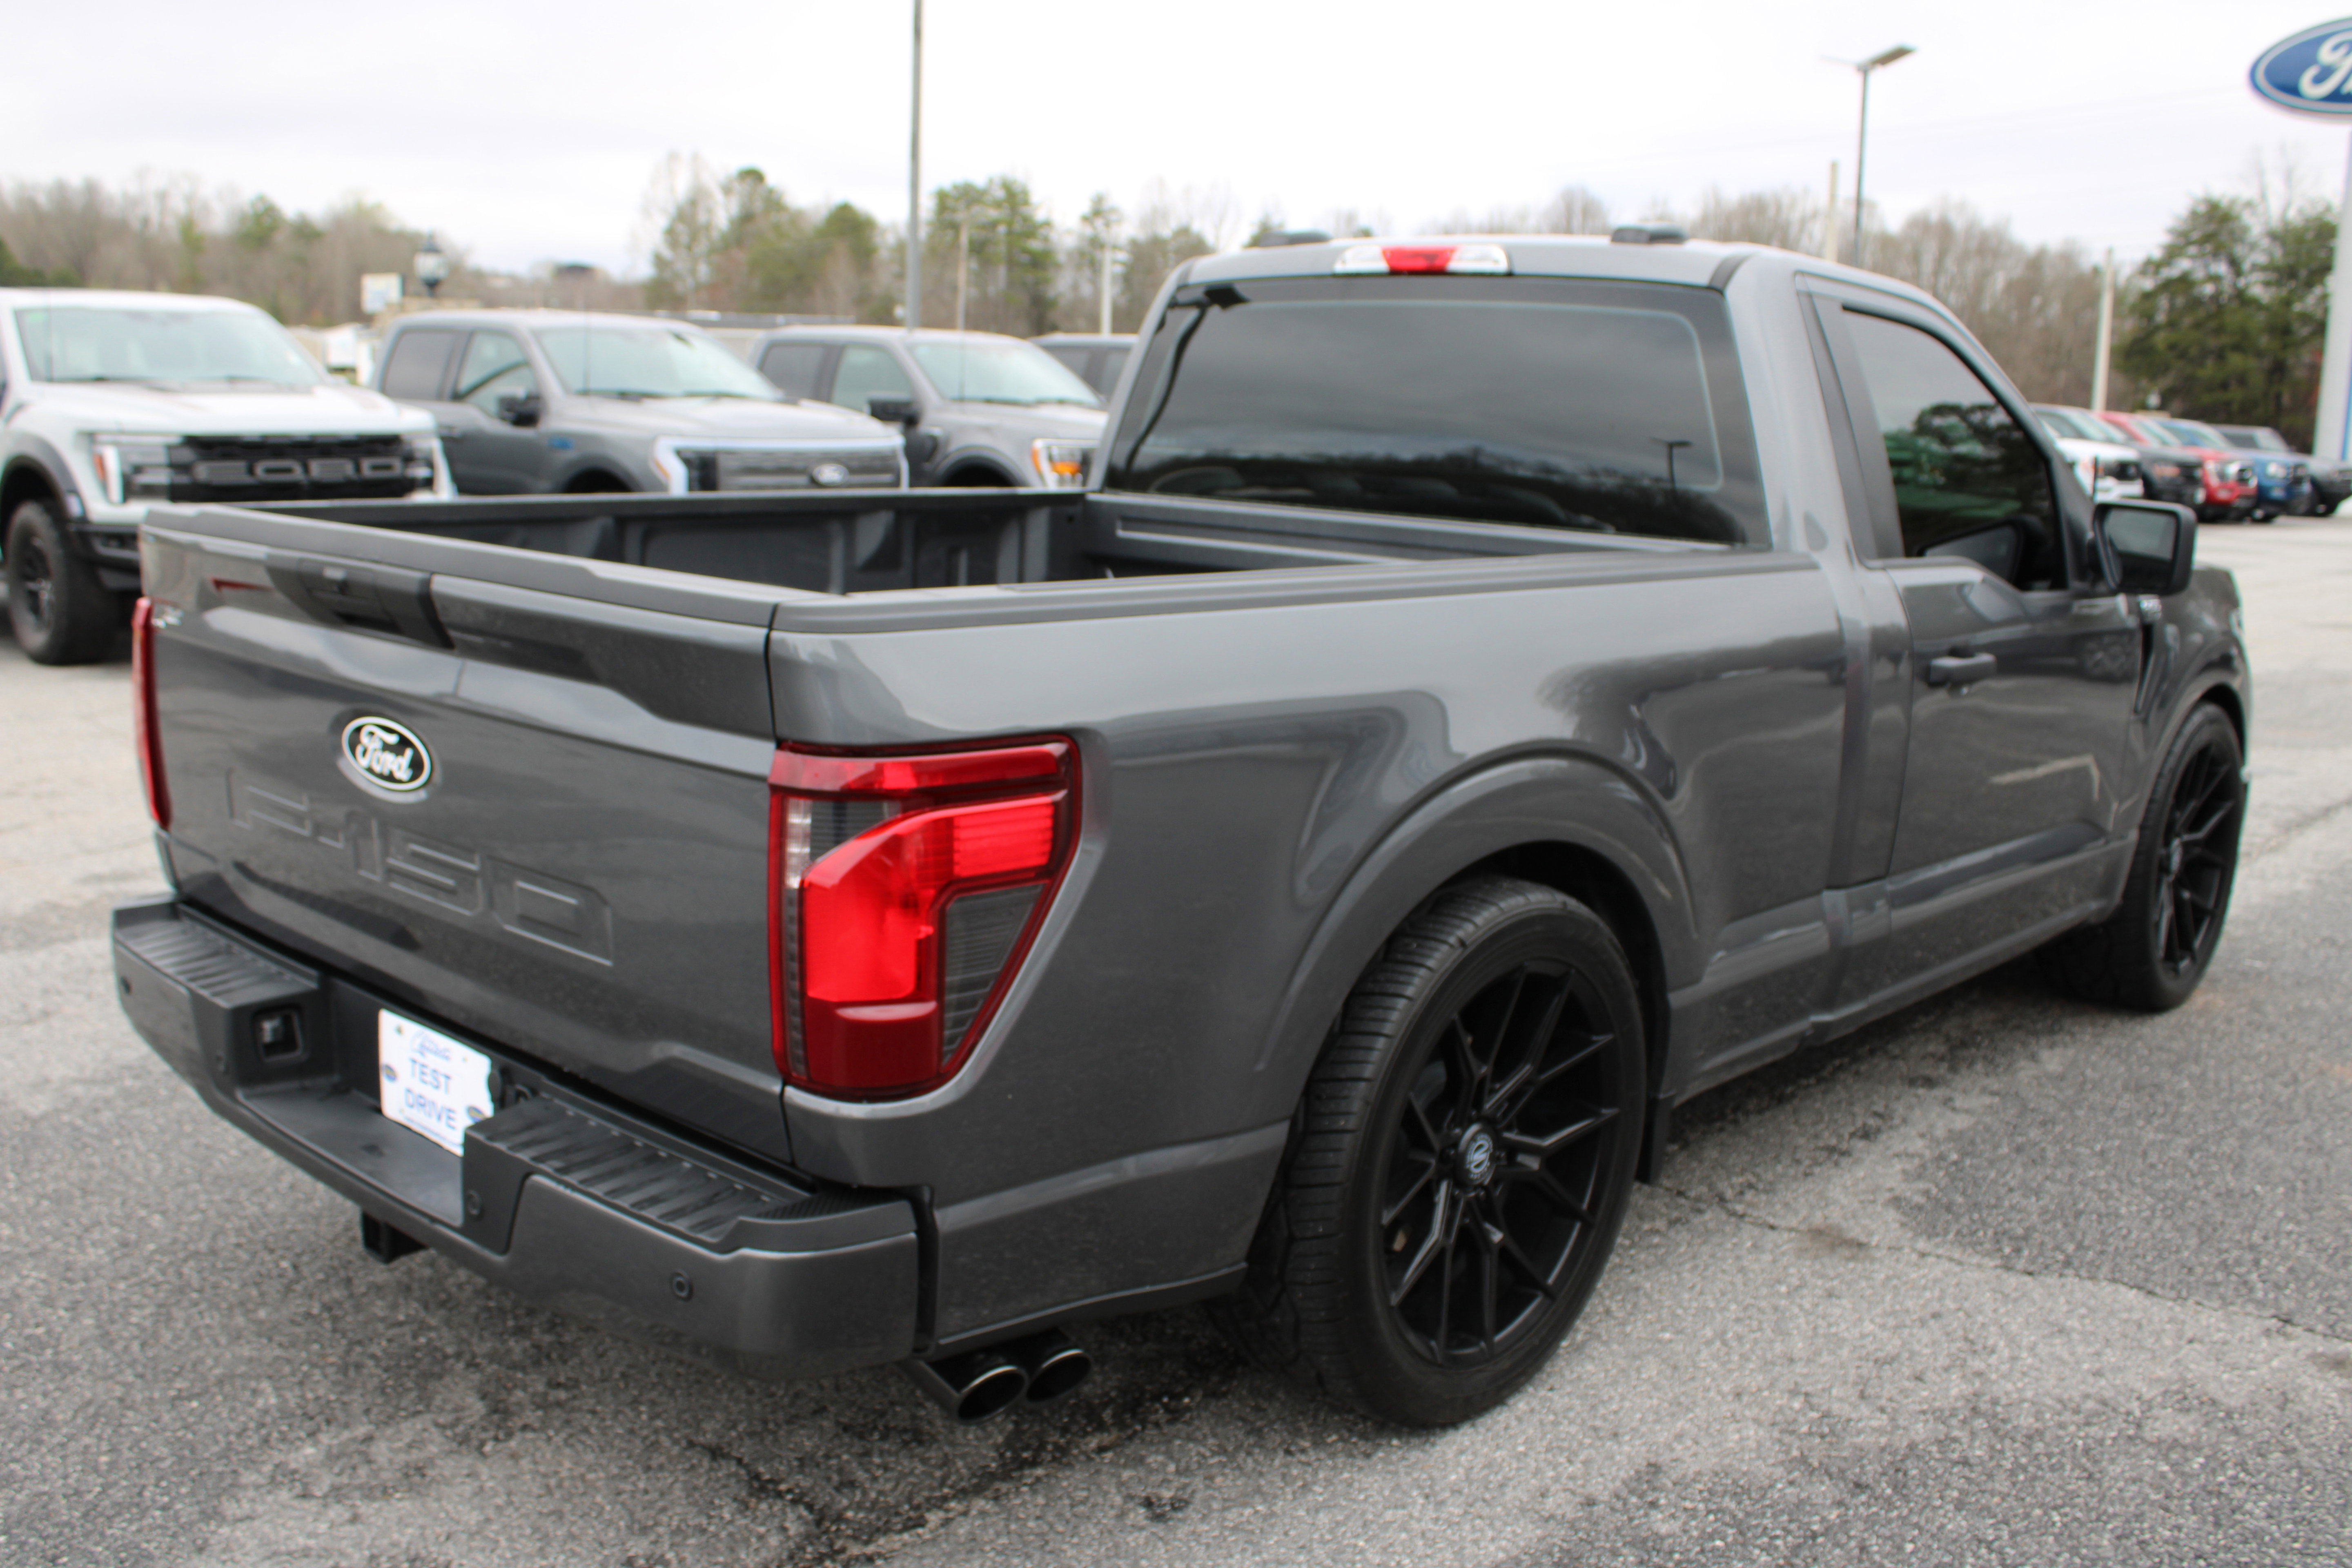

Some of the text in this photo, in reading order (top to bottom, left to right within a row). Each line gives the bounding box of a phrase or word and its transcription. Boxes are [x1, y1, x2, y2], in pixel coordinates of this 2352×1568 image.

[192, 457, 403, 485] FORD
[355, 724, 414, 782] Ford
[225, 767, 613, 967] F-150
[409, 1057, 452, 1094] TEST
[404, 1087, 457, 1130] DRIVE
